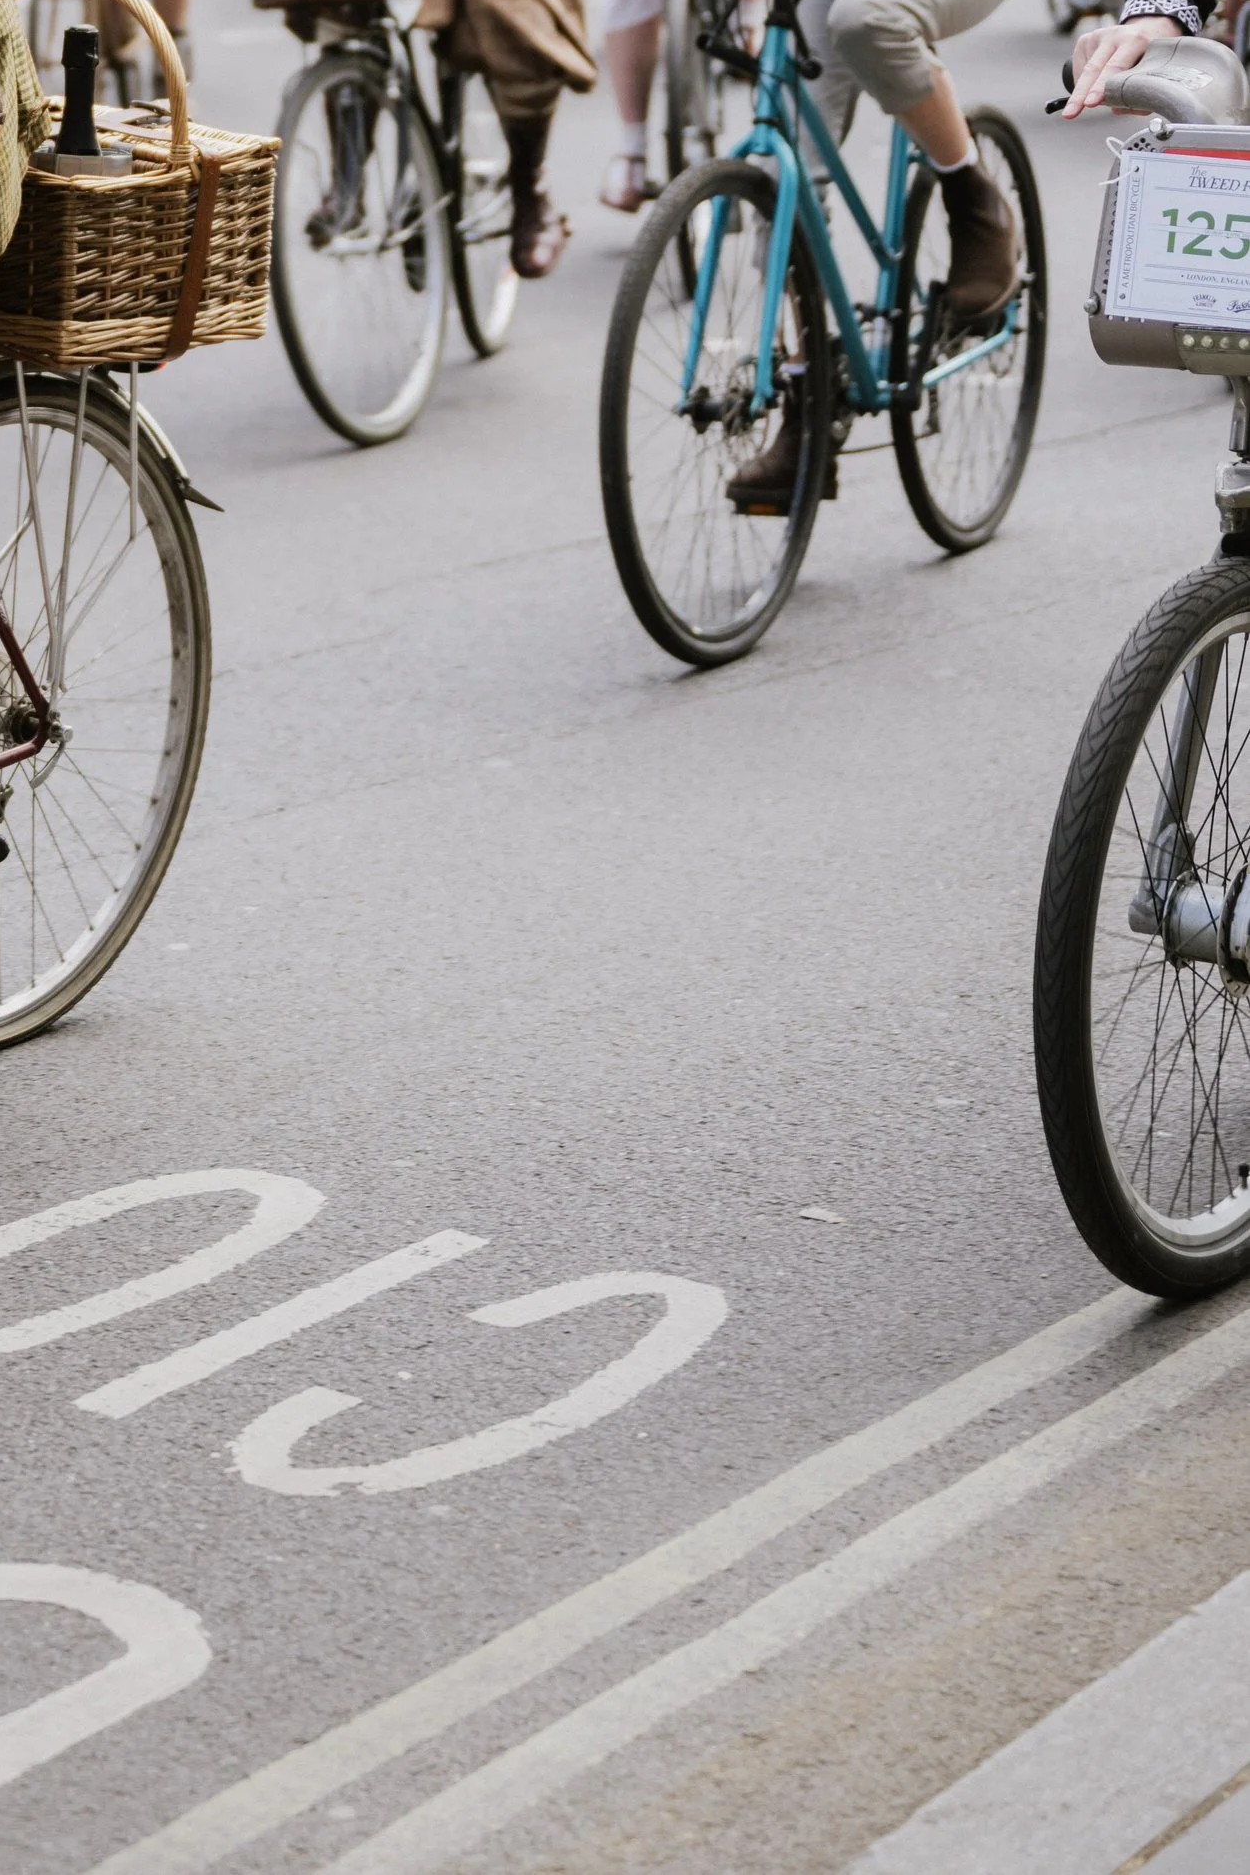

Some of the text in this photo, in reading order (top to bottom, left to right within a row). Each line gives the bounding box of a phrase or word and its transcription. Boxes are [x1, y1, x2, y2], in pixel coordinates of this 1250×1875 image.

[1190, 165, 1207, 176] The
[1129, 176, 1140, 212] BICYCLE
[1188, 176, 1241, 191] TWEED
[1122, 213, 1137, 280] METROPOLITAN
